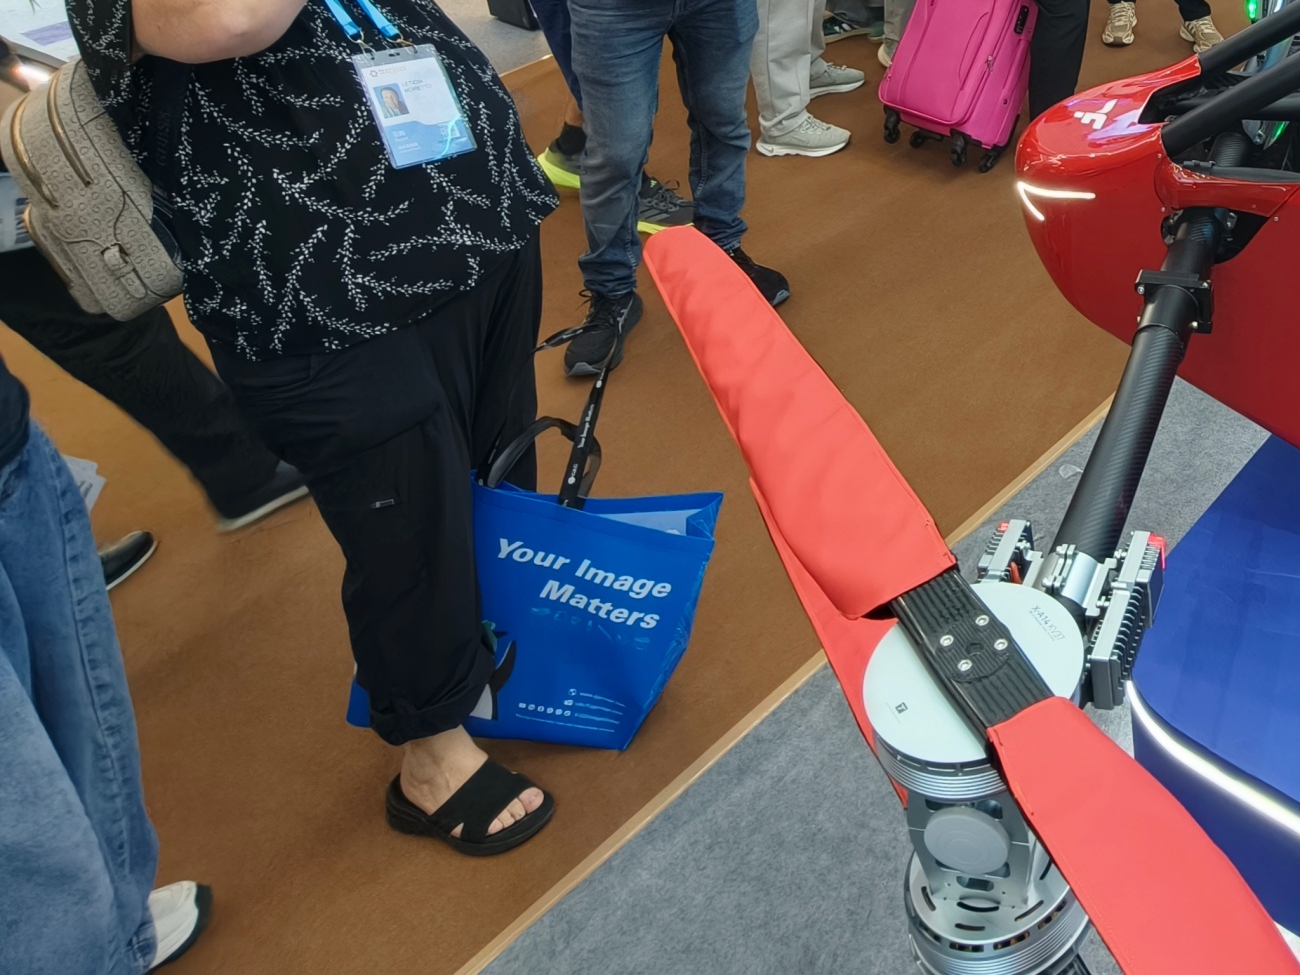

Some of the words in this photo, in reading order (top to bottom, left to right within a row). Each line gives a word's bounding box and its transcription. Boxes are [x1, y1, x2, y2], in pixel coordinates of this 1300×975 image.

[498, 538, 570, 570] Your
[575, 559, 672, 599] Image
[540, 580, 661, 629] Matters
